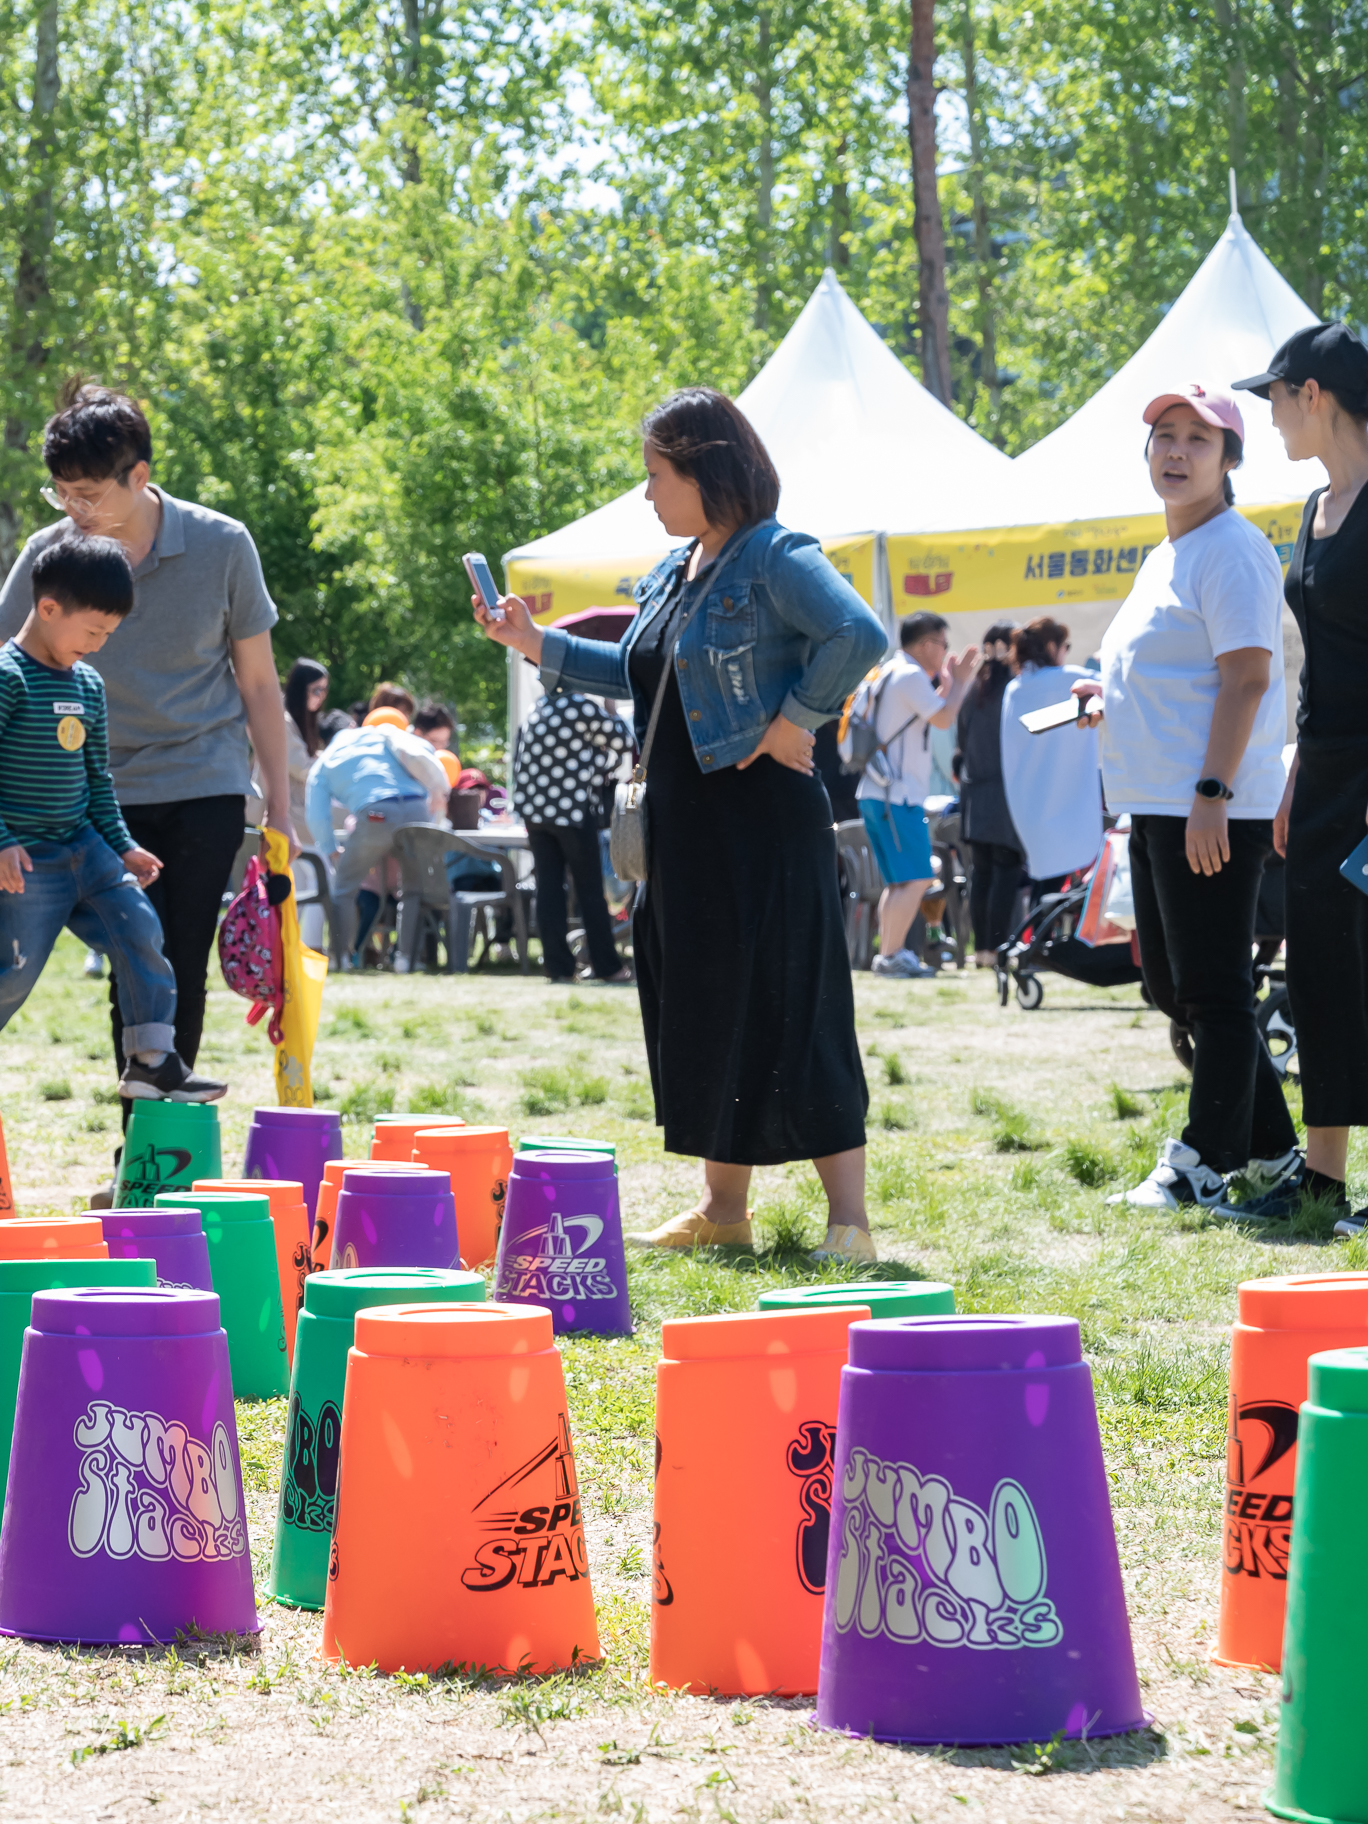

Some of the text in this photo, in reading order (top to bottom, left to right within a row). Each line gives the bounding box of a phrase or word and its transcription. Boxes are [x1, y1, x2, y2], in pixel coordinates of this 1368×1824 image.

[498, 1267, 618, 1300] STACKS
[513, 1254, 606, 1273] SPEED
[73, 1400, 238, 1530] JUMBO
[842, 1446, 1048, 1611] JUMBO
